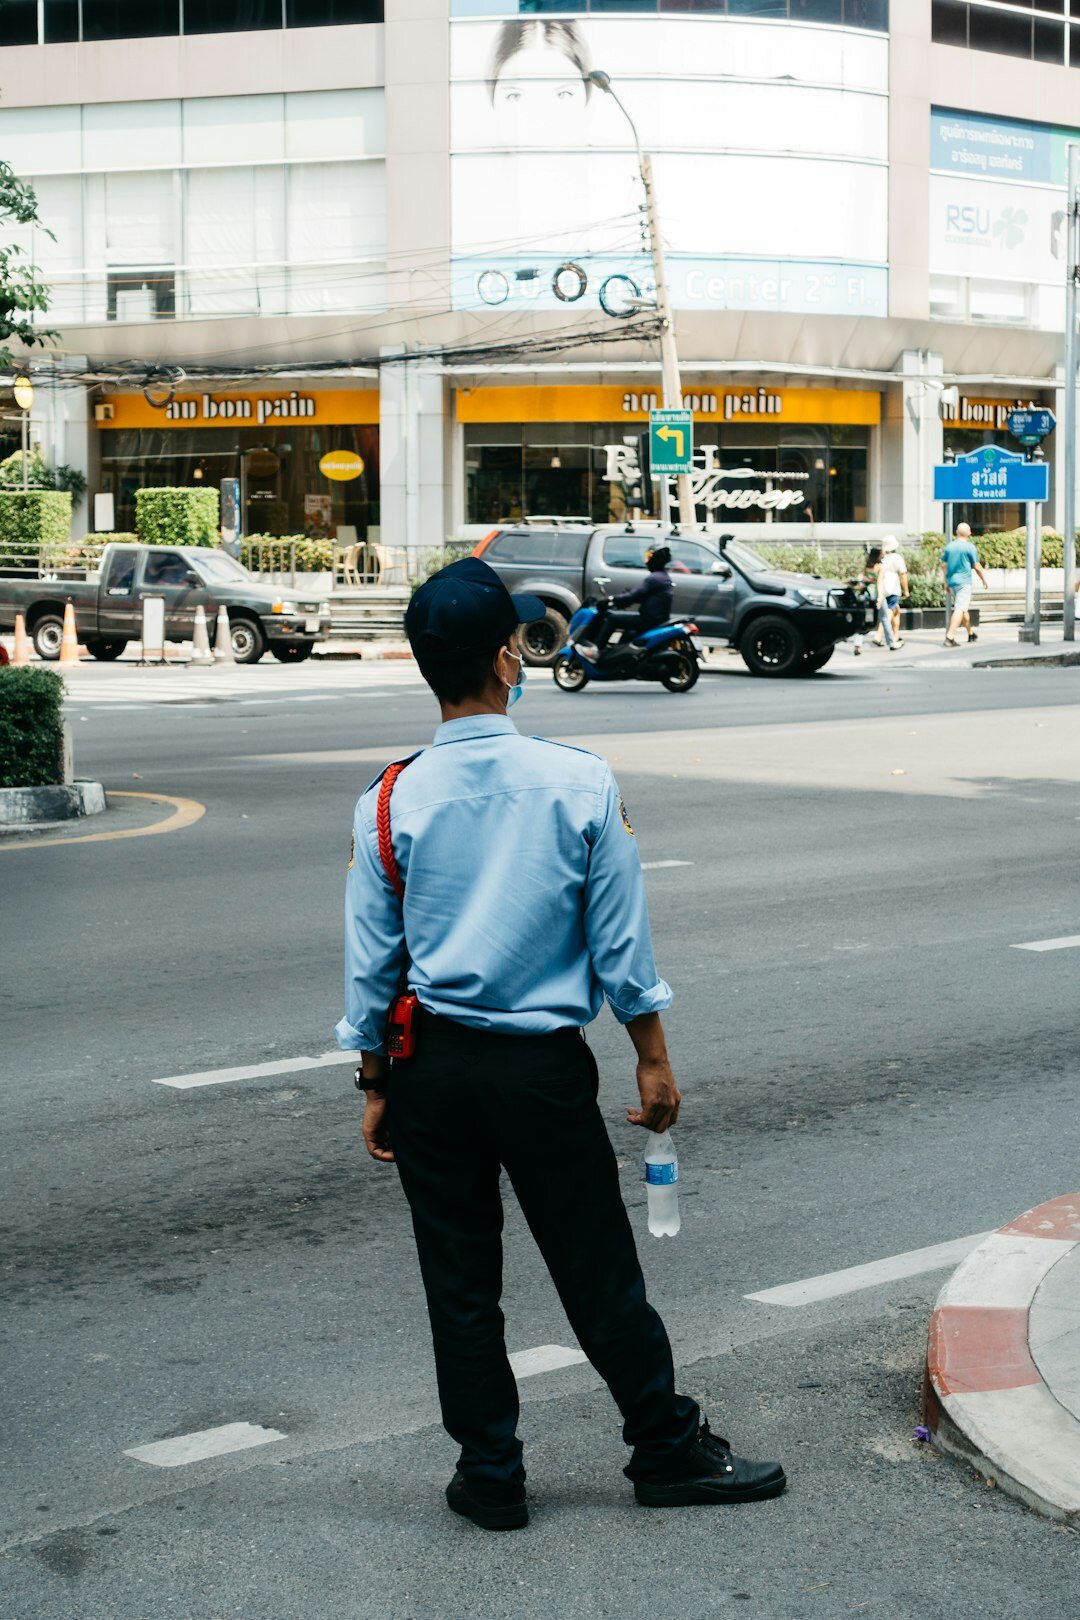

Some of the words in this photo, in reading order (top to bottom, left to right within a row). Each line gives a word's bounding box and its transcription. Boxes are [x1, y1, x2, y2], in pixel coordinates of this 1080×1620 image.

[946, 204, 991, 235] RSU
[685, 269, 792, 303] Center
[165, 400, 197, 419] au
[202, 393, 252, 419] bon
[257, 391, 315, 424] pain
[622, 393, 657, 412] au
[683, 394, 717, 413] on
[724, 387, 783, 420] pain
[962, 397, 995, 422] bon
[971, 467, 1008, 486] สวัสดี
[972, 488, 1007, 498] Sawatdi
